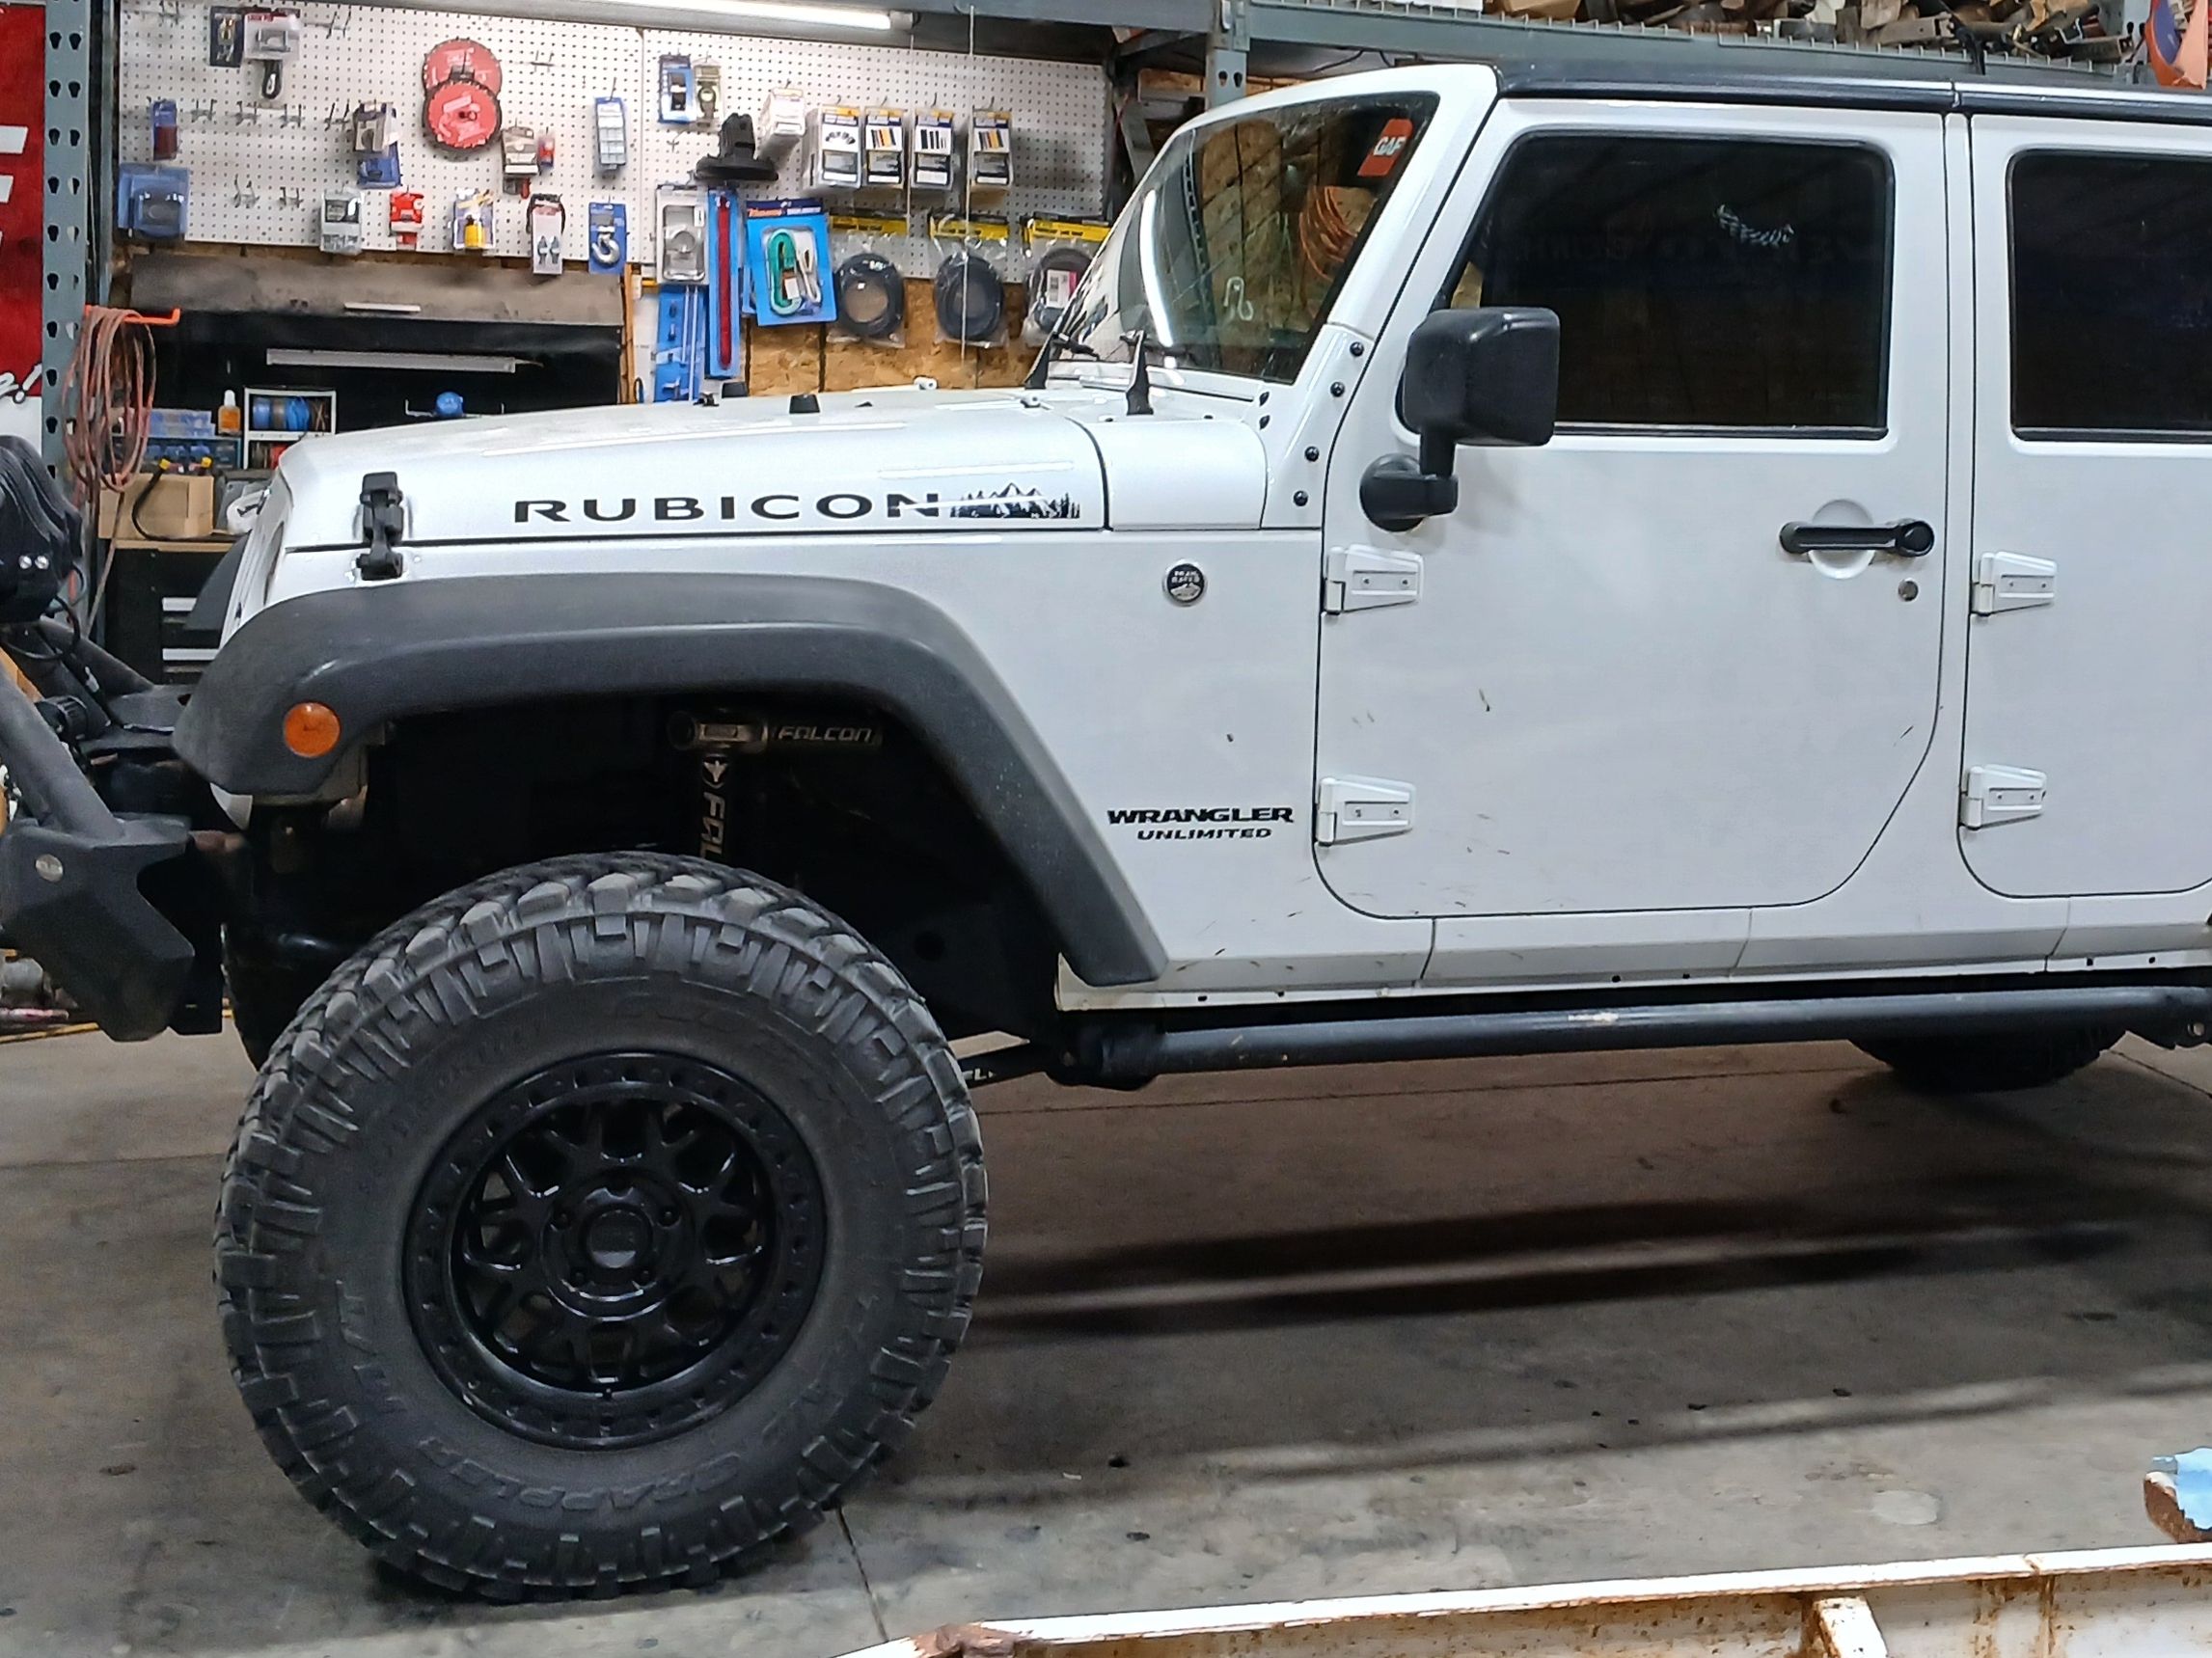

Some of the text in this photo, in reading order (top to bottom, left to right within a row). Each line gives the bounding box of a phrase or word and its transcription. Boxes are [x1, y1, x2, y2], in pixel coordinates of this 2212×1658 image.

[514, 492, 941, 524] RUBICON
[778, 725, 872, 743] FALCON
[1106, 807, 1294, 825] WRANGLER
[1136, 828, 1272, 841] UNLIMITED
